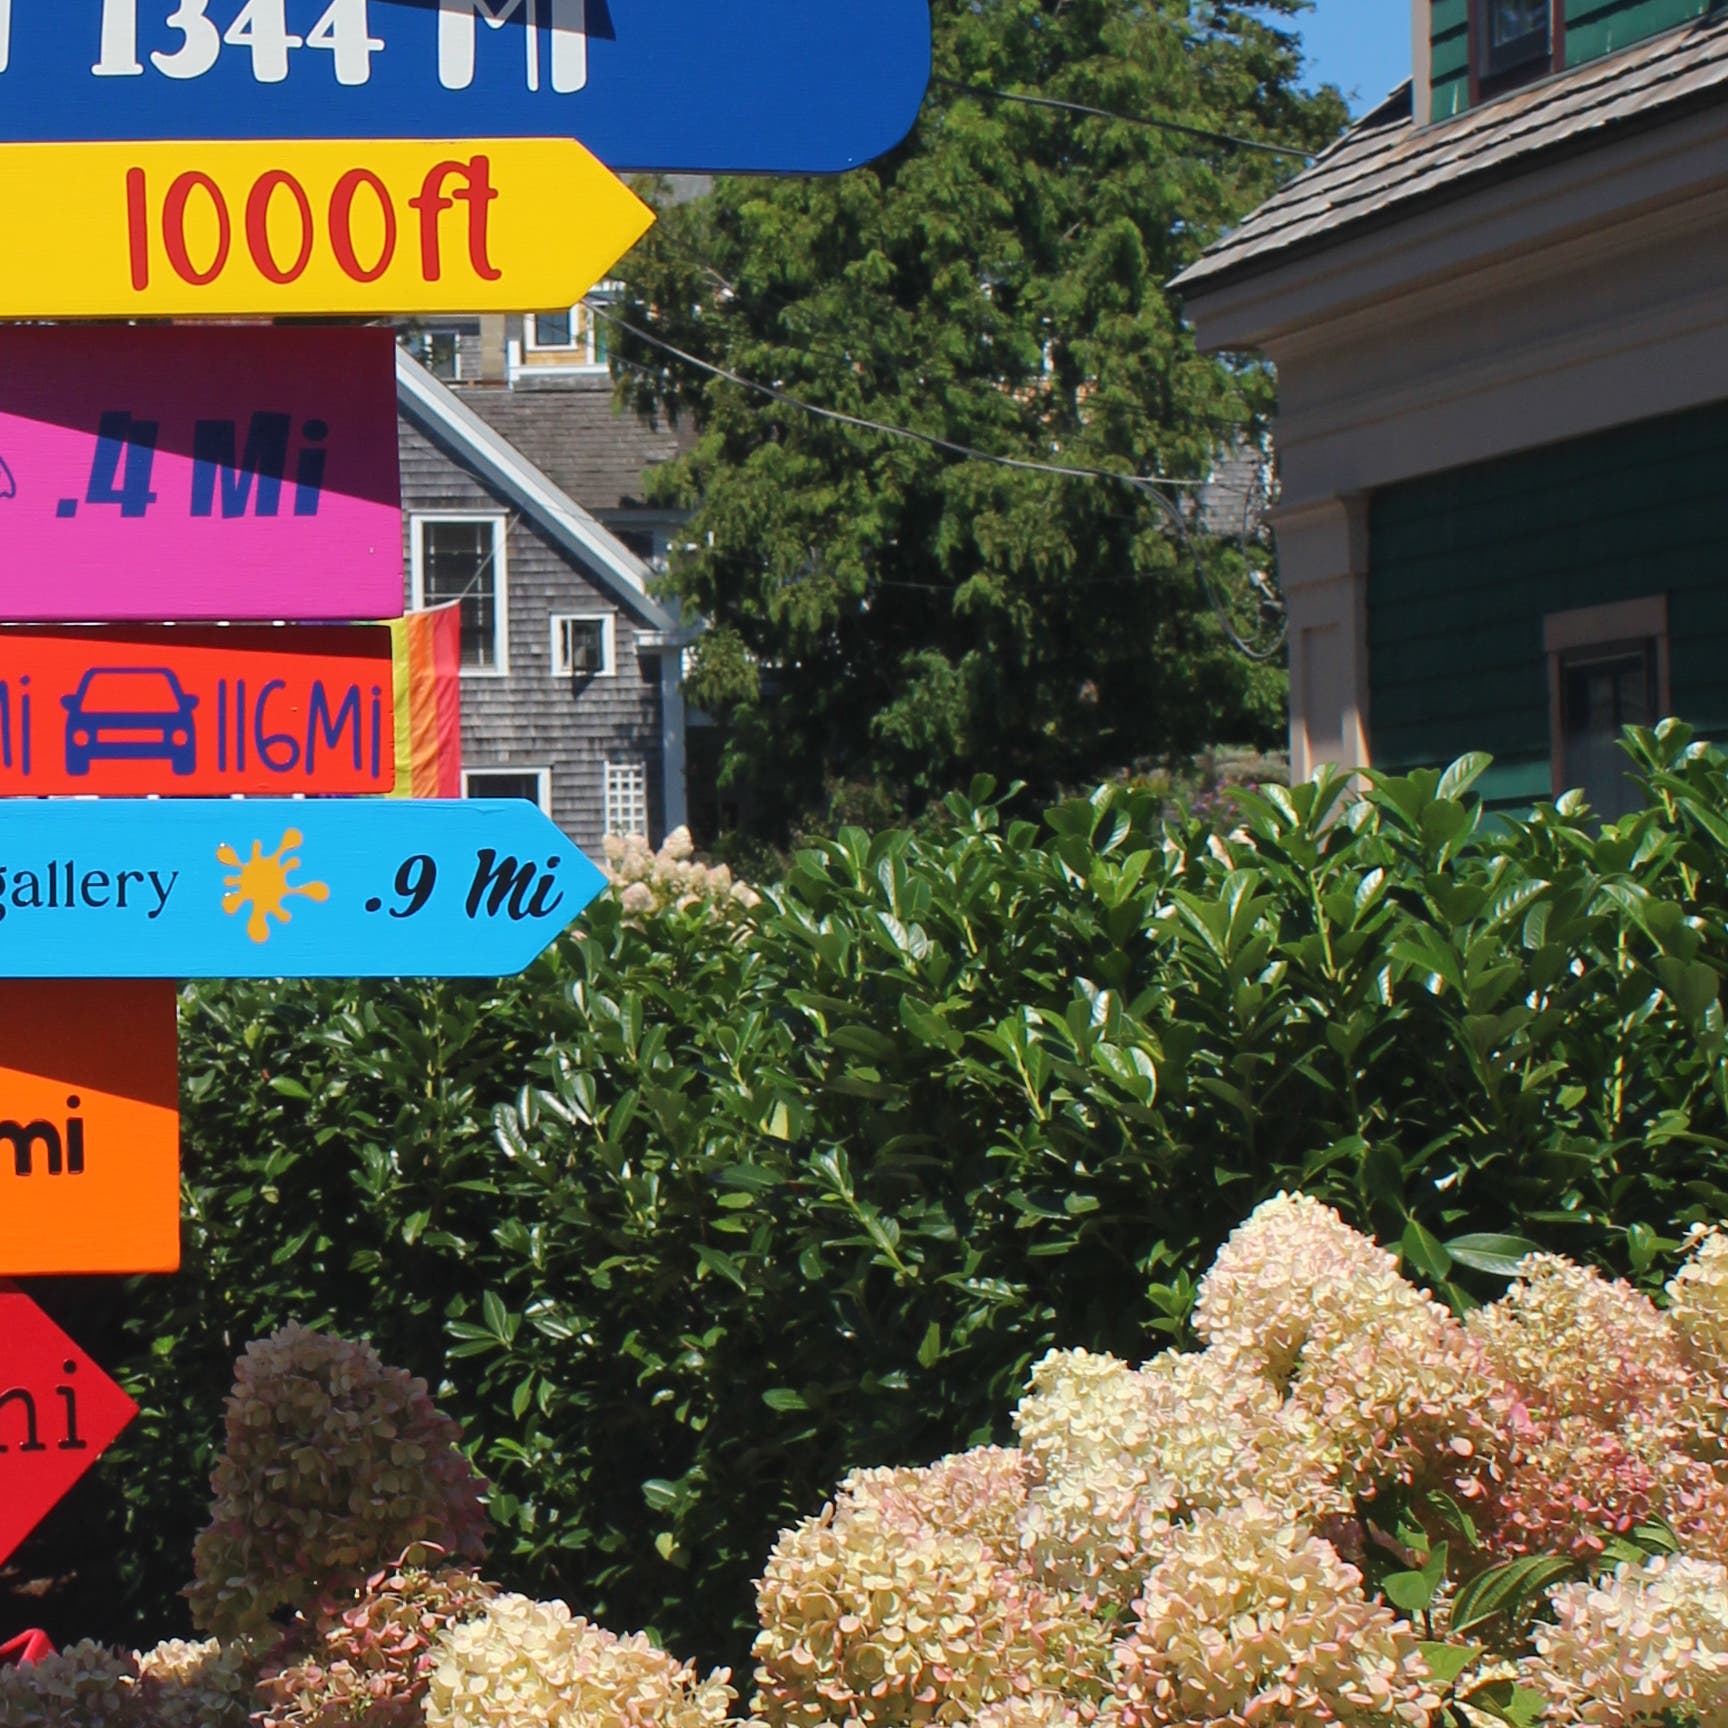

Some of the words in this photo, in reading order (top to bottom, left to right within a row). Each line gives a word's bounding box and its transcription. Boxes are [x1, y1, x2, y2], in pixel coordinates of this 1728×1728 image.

[125, 154, 502, 292] 1000ft
[55, 411, 159, 519] .4
[190, 410, 330, 519] Mi
[363, 854, 435, 918] .9
[465, 849, 563, 919] Mi
